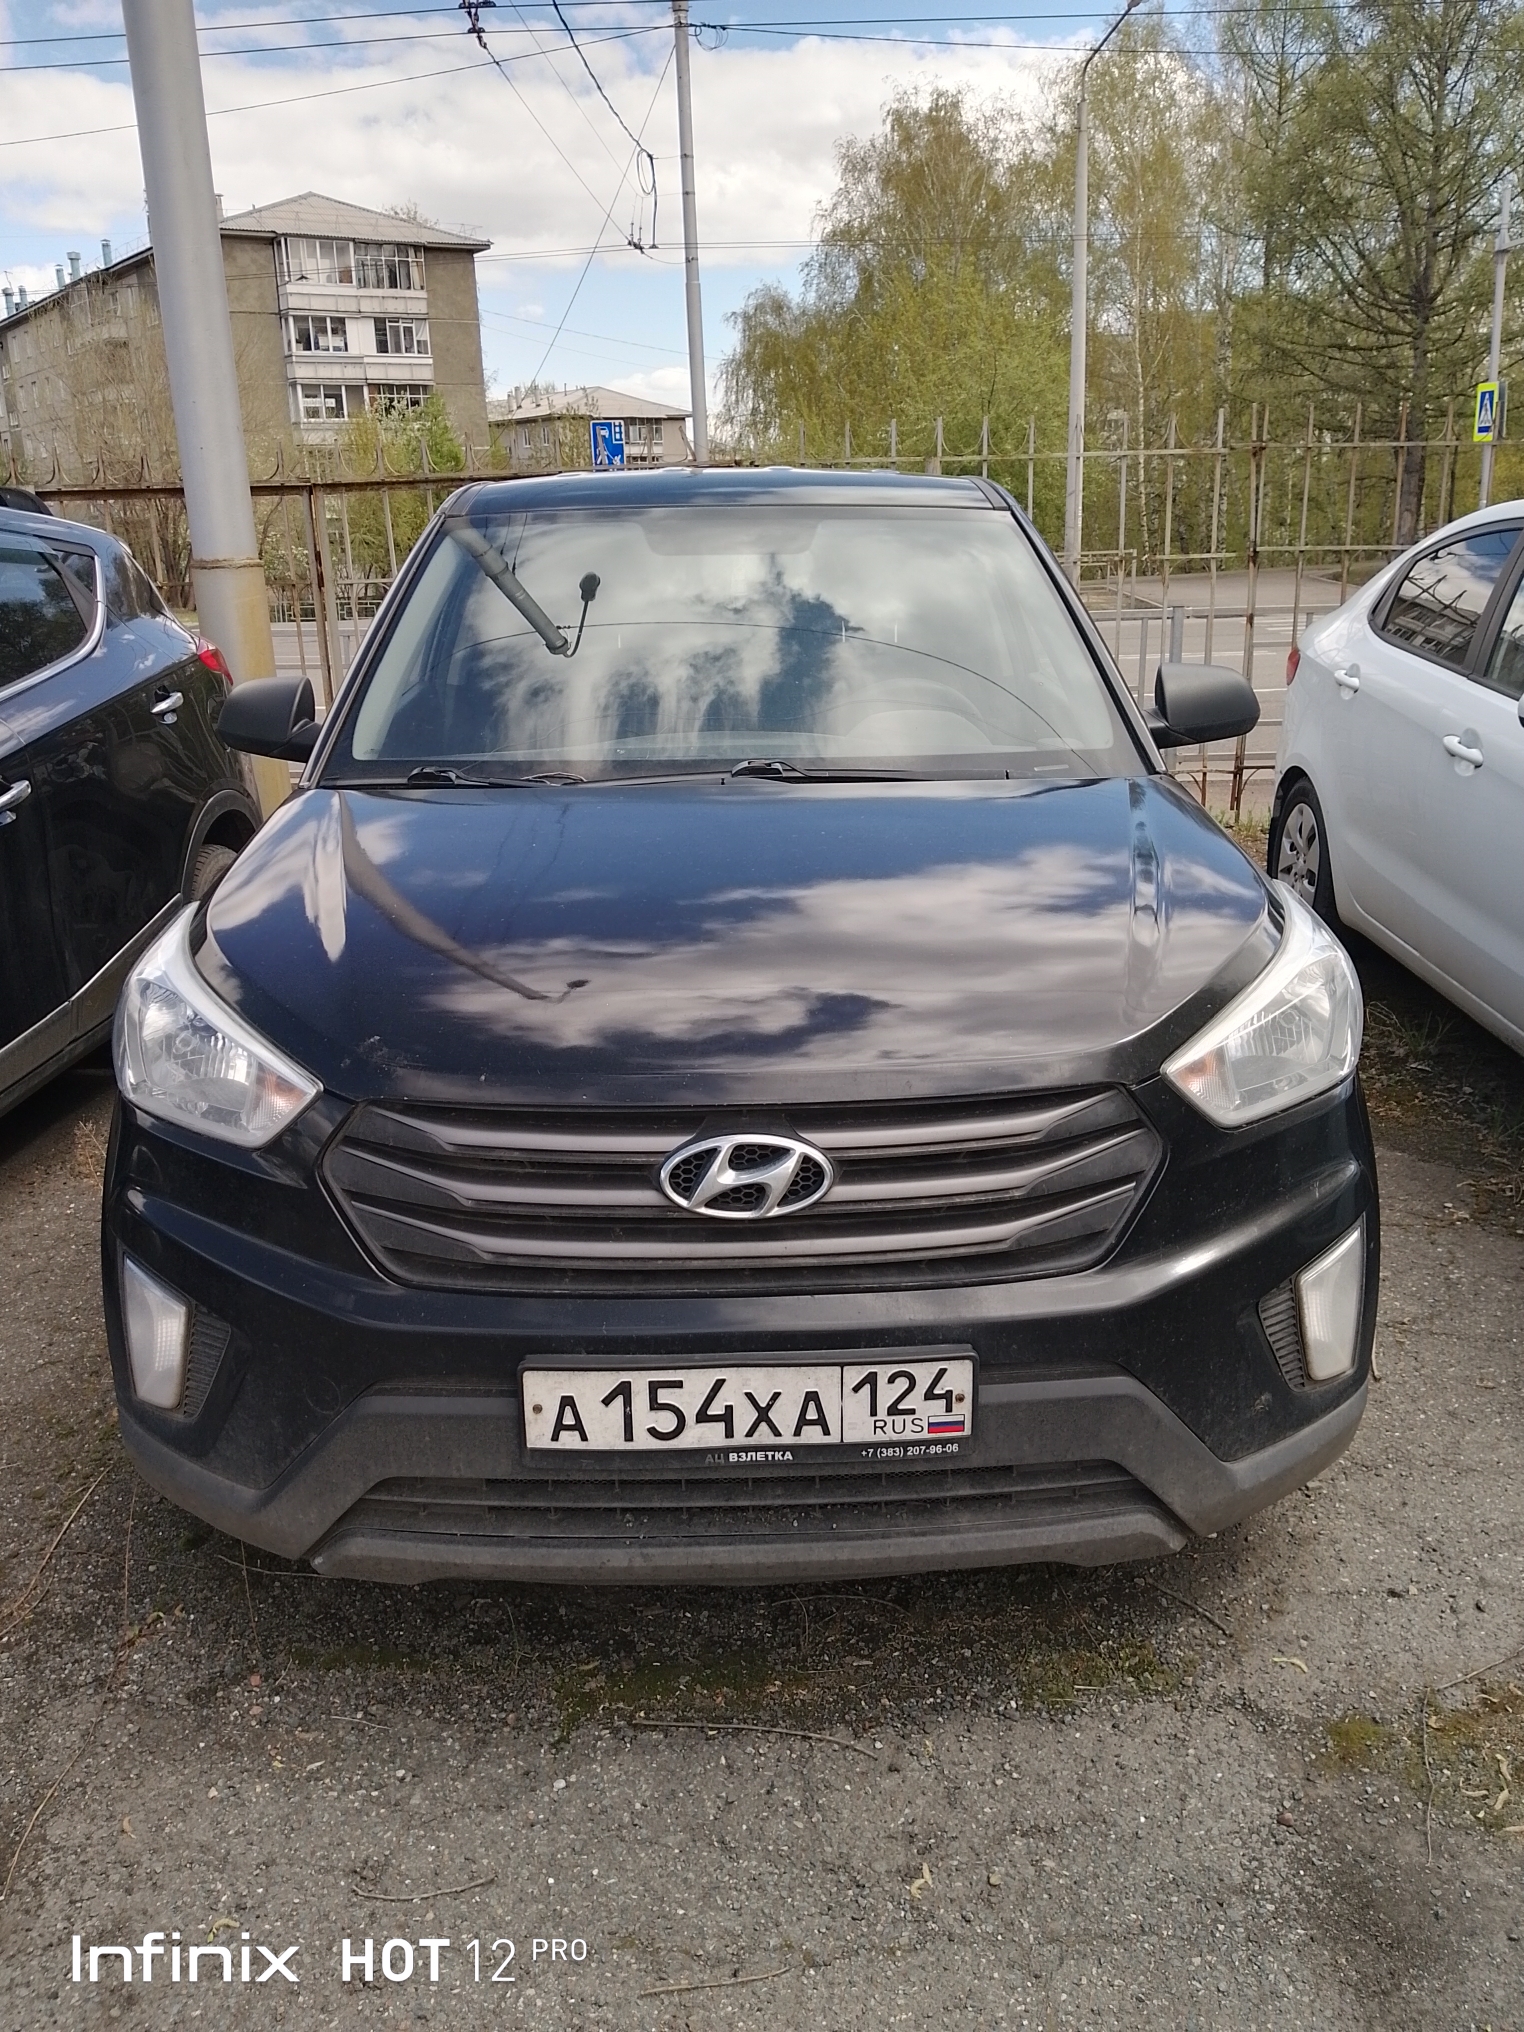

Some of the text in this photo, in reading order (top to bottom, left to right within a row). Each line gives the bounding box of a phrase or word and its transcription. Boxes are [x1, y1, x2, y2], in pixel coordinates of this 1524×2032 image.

[851, 1367, 954, 1417] 124
[873, 1417, 925, 1435] RUS
[728, 1450, 793, 1462] ВЗЛЕТКА
[861, 1443, 959, 1458] +7 (383) 207-96-06
